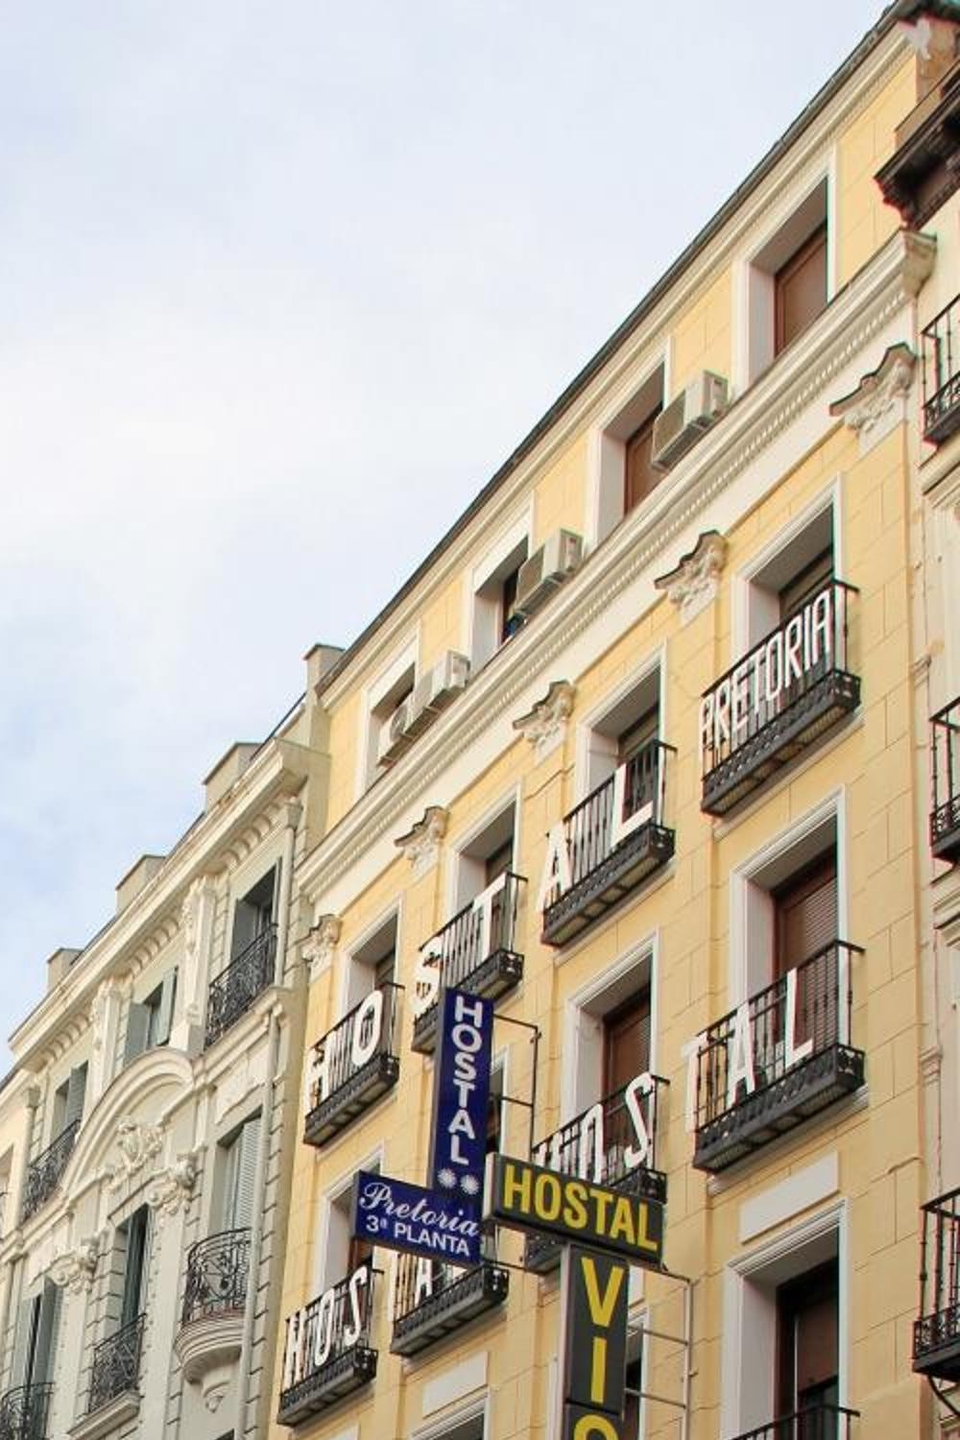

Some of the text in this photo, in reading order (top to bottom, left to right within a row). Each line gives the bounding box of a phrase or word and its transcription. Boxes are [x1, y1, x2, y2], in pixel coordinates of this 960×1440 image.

[700, 588, 831, 752] PRETORIA
[448, 996, 482, 1166] HOSTAL
[359, 1182, 479, 1237] Pretoria
[394, 1222, 470, 1257] PLANTA
[504, 1163, 658, 1252] HOSTAL
